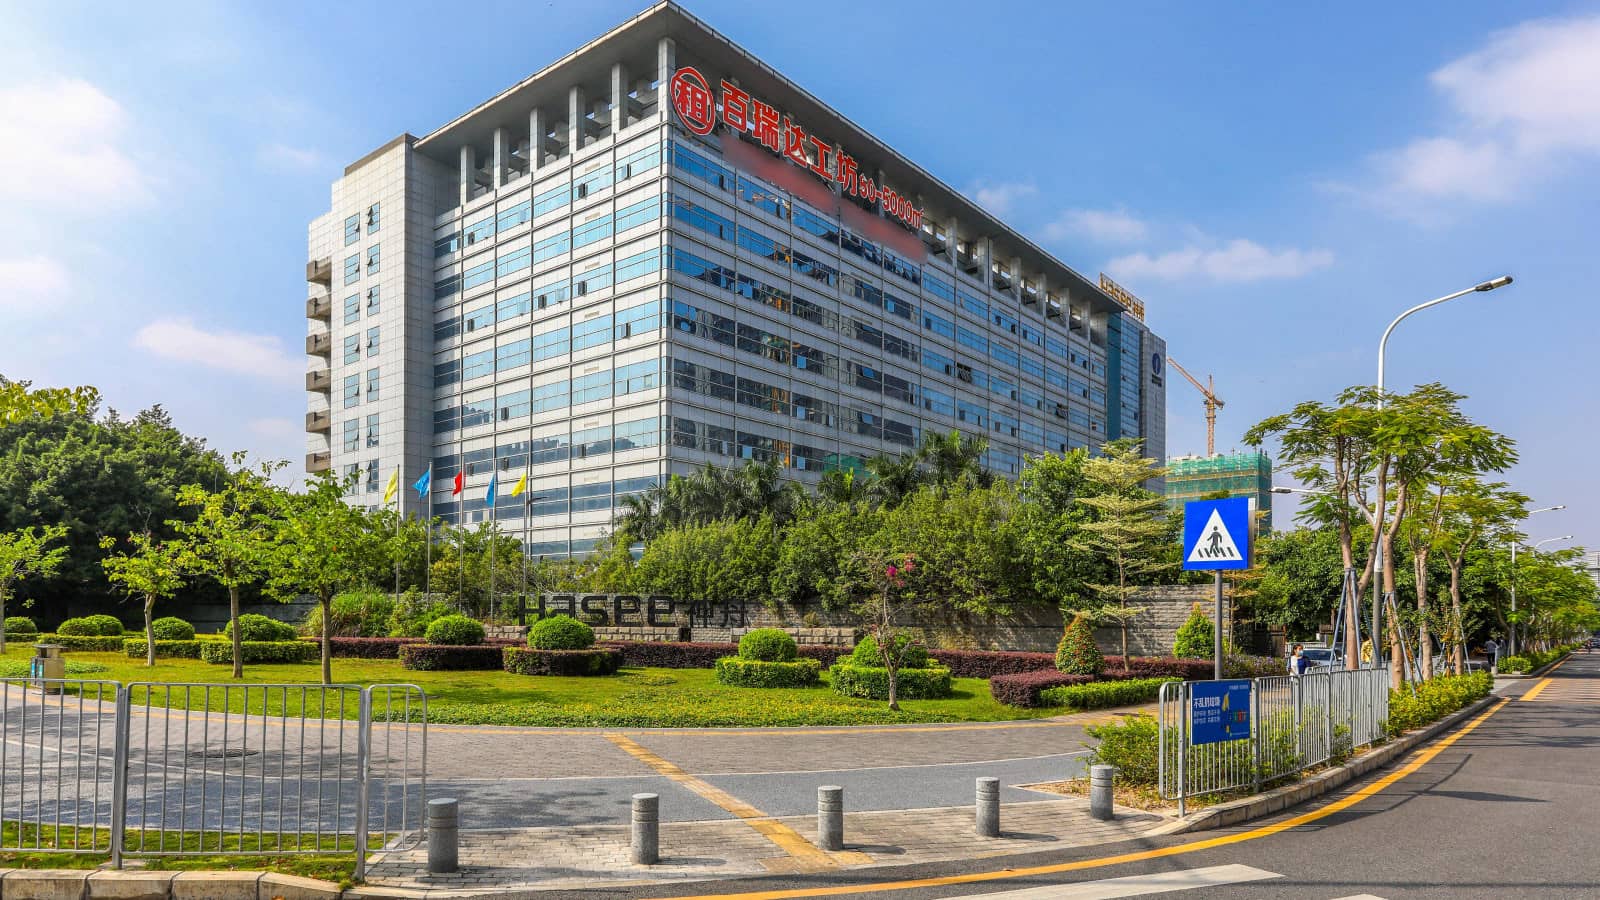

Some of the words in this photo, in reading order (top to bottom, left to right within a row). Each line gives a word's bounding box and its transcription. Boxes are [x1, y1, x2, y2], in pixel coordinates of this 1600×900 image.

[673, 72, 712, 130] 租
[720, 78, 857, 197] 百瑞达工坊
